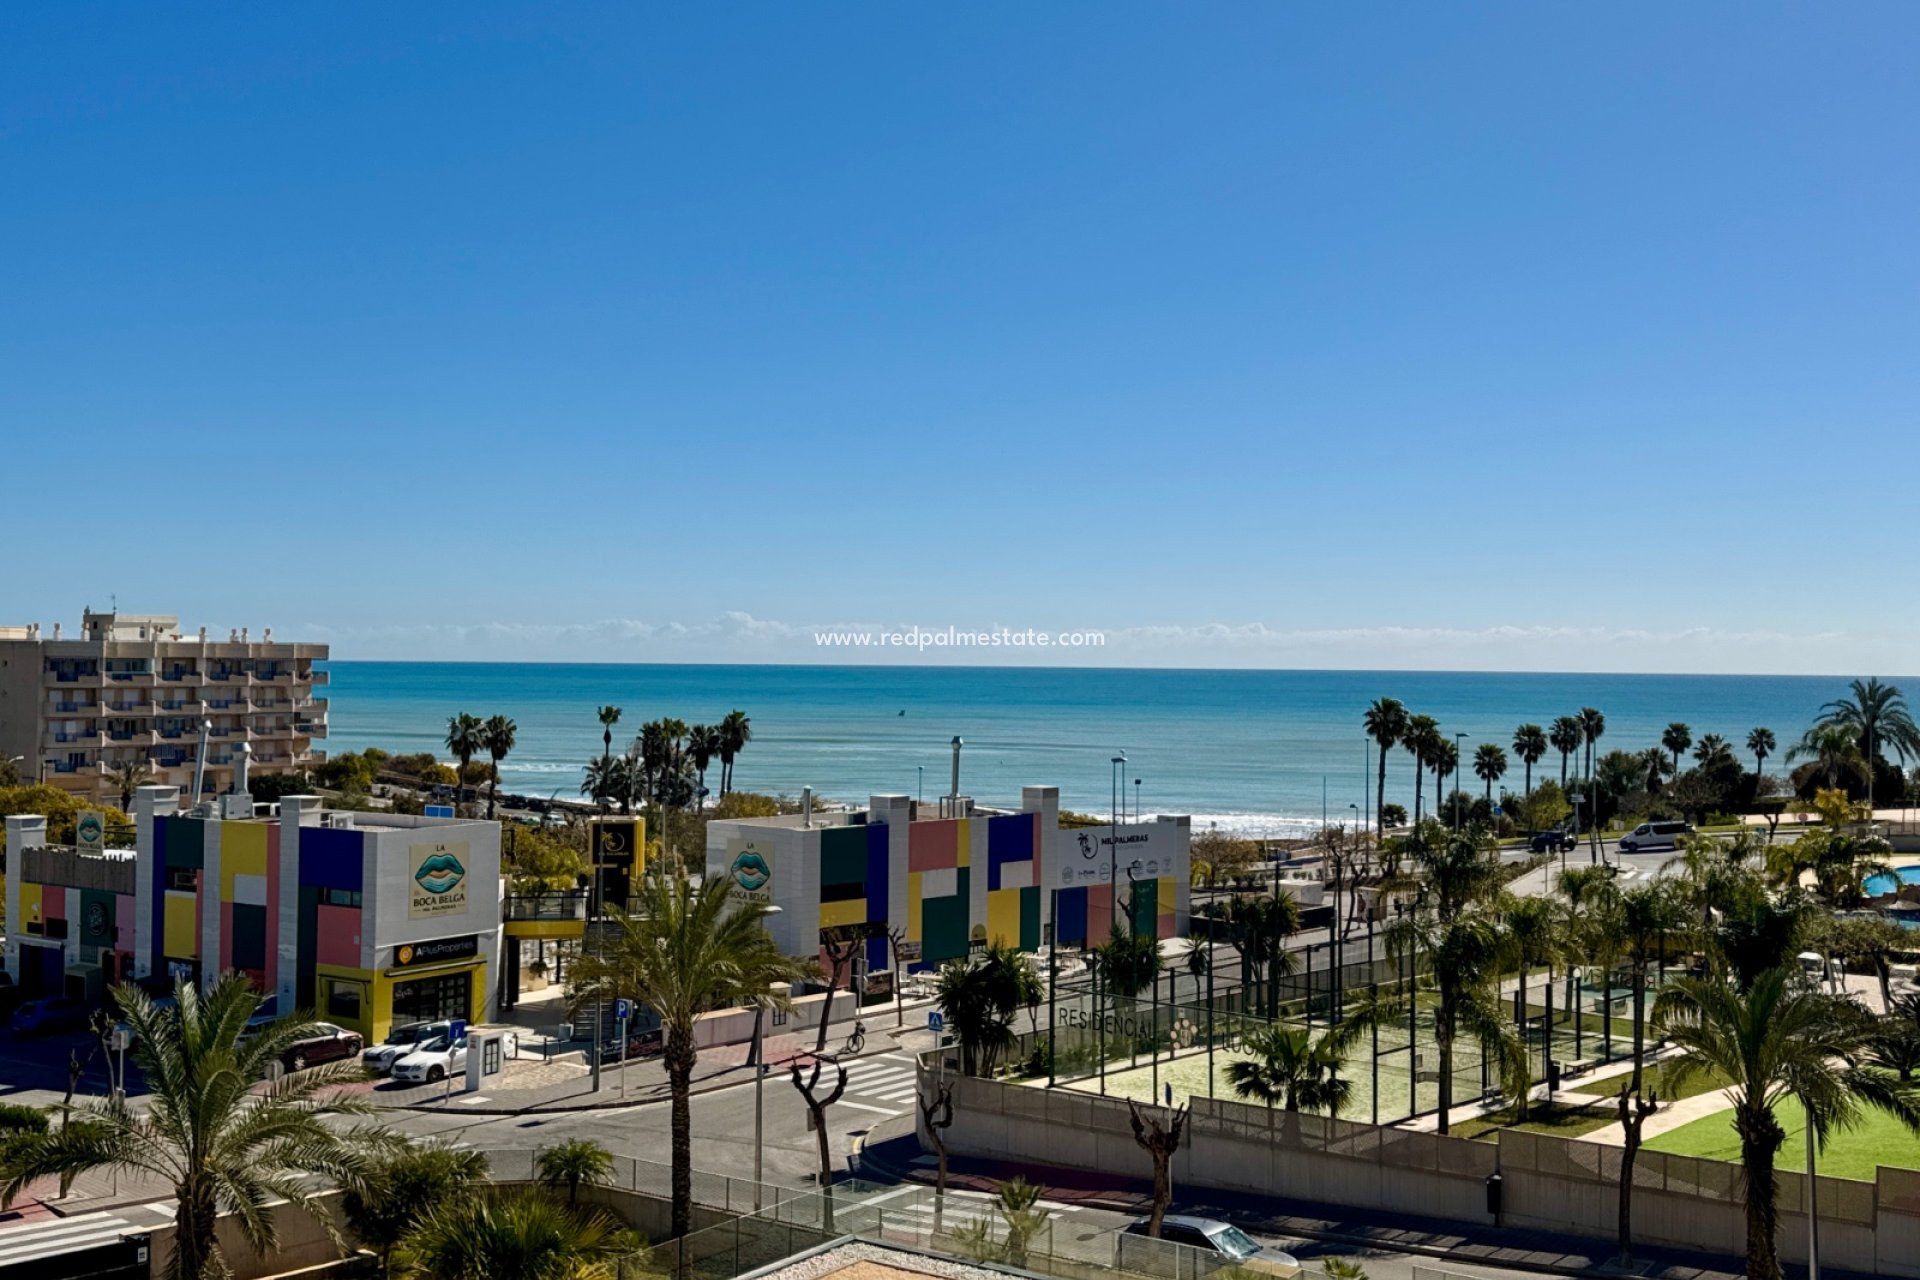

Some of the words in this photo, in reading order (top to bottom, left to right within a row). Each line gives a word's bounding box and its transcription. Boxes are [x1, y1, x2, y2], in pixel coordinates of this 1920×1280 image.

[413, 897, 437, 907] BOCA
[439, 893, 465, 905] BELGA
[618, 1001, 626, 1016] P
